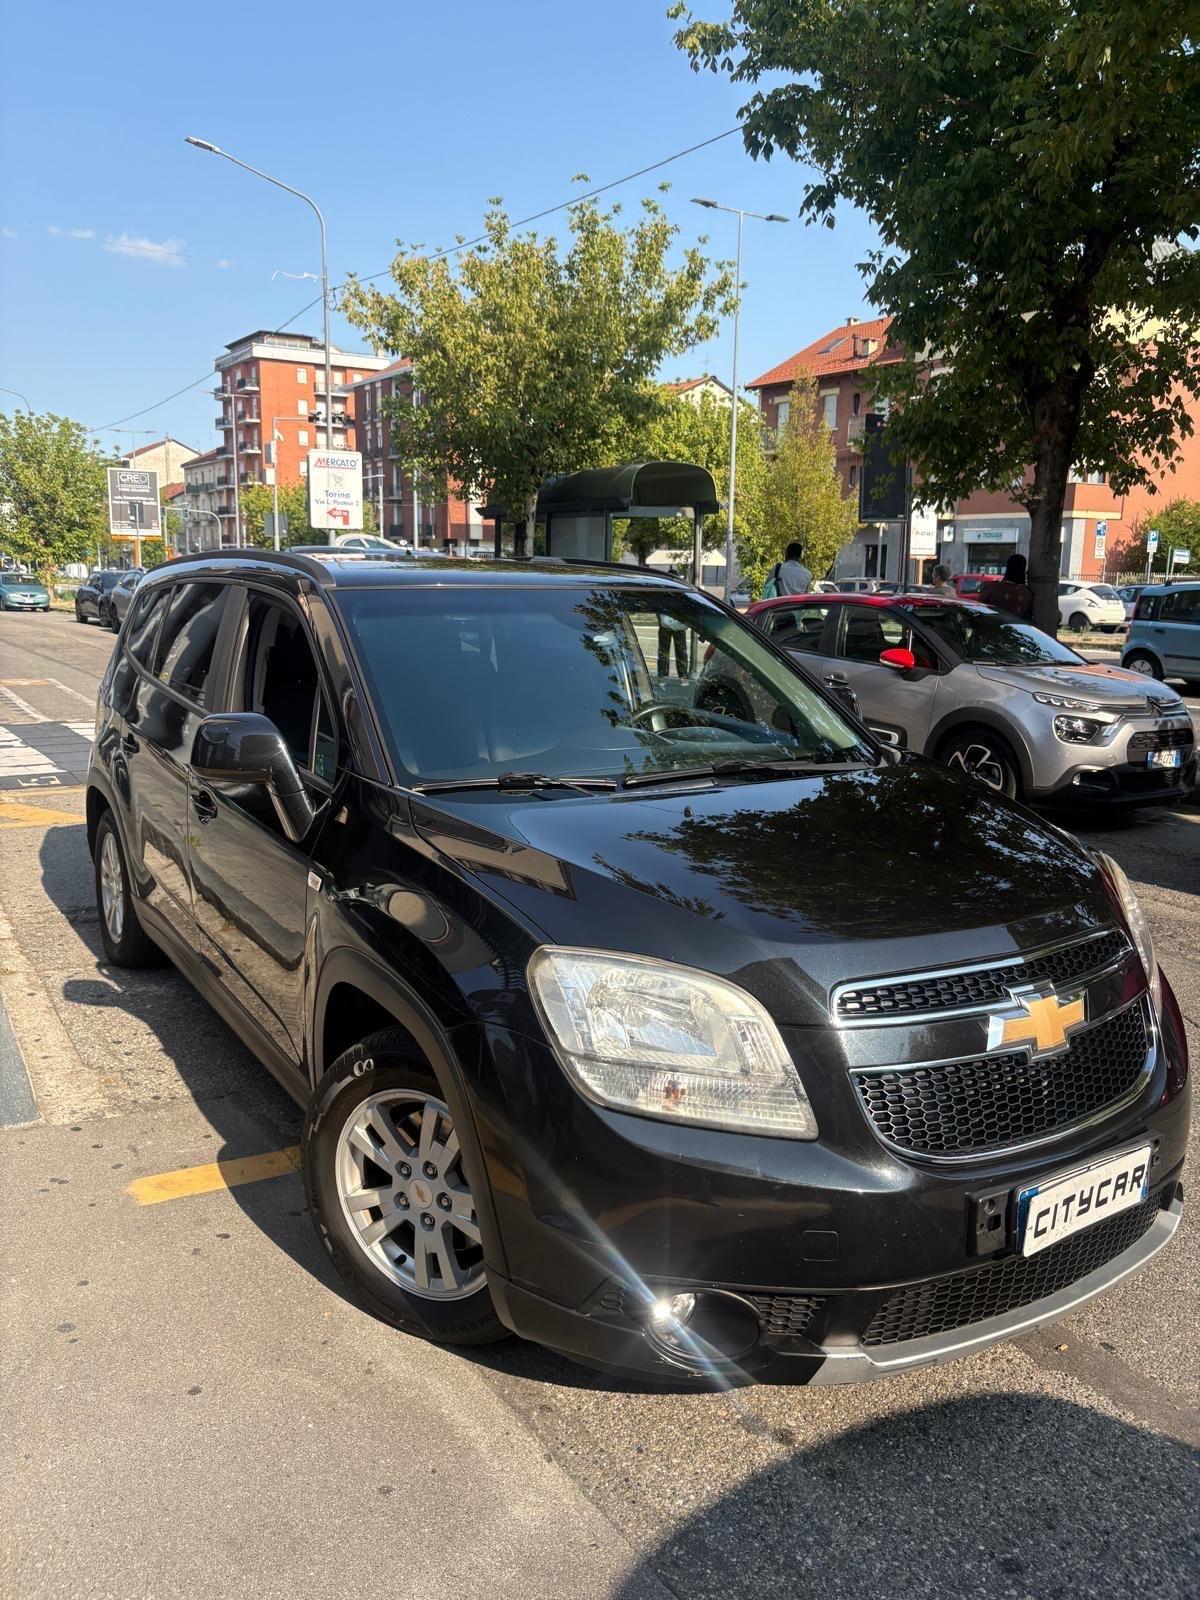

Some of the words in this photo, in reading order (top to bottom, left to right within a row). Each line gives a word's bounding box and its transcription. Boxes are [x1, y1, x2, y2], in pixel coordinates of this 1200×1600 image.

[314, 457, 357, 468] MERCATO
[119, 474, 147, 483] CREO
[324, 489, 351, 499] Torino
[1033, 1163, 1146, 1239] CITYCAR
